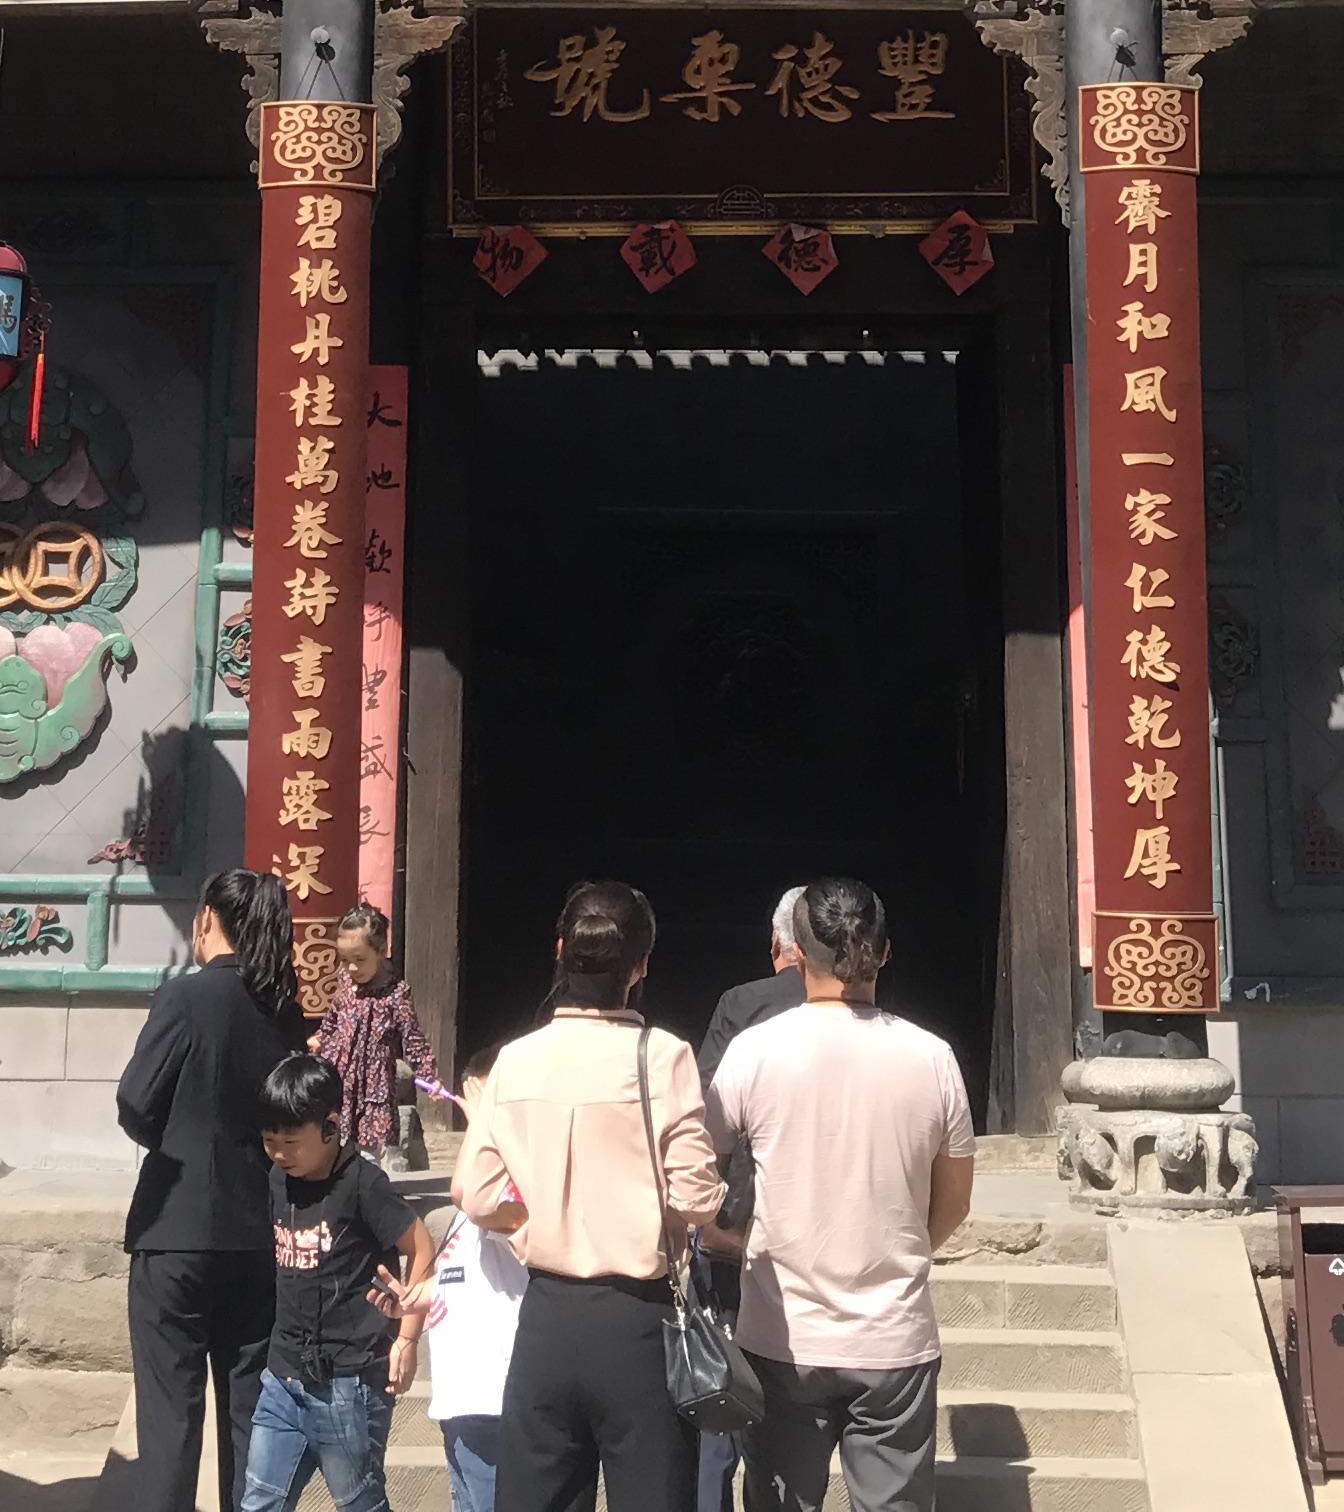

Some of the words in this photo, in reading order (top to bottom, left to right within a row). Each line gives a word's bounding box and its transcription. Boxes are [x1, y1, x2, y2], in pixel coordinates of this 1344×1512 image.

[272, 194, 348, 901] 碧桃丹桂萬卷詩書雨露深
[1114, 178, 1182, 889] 霽月和風一家仁德乾坤厚
